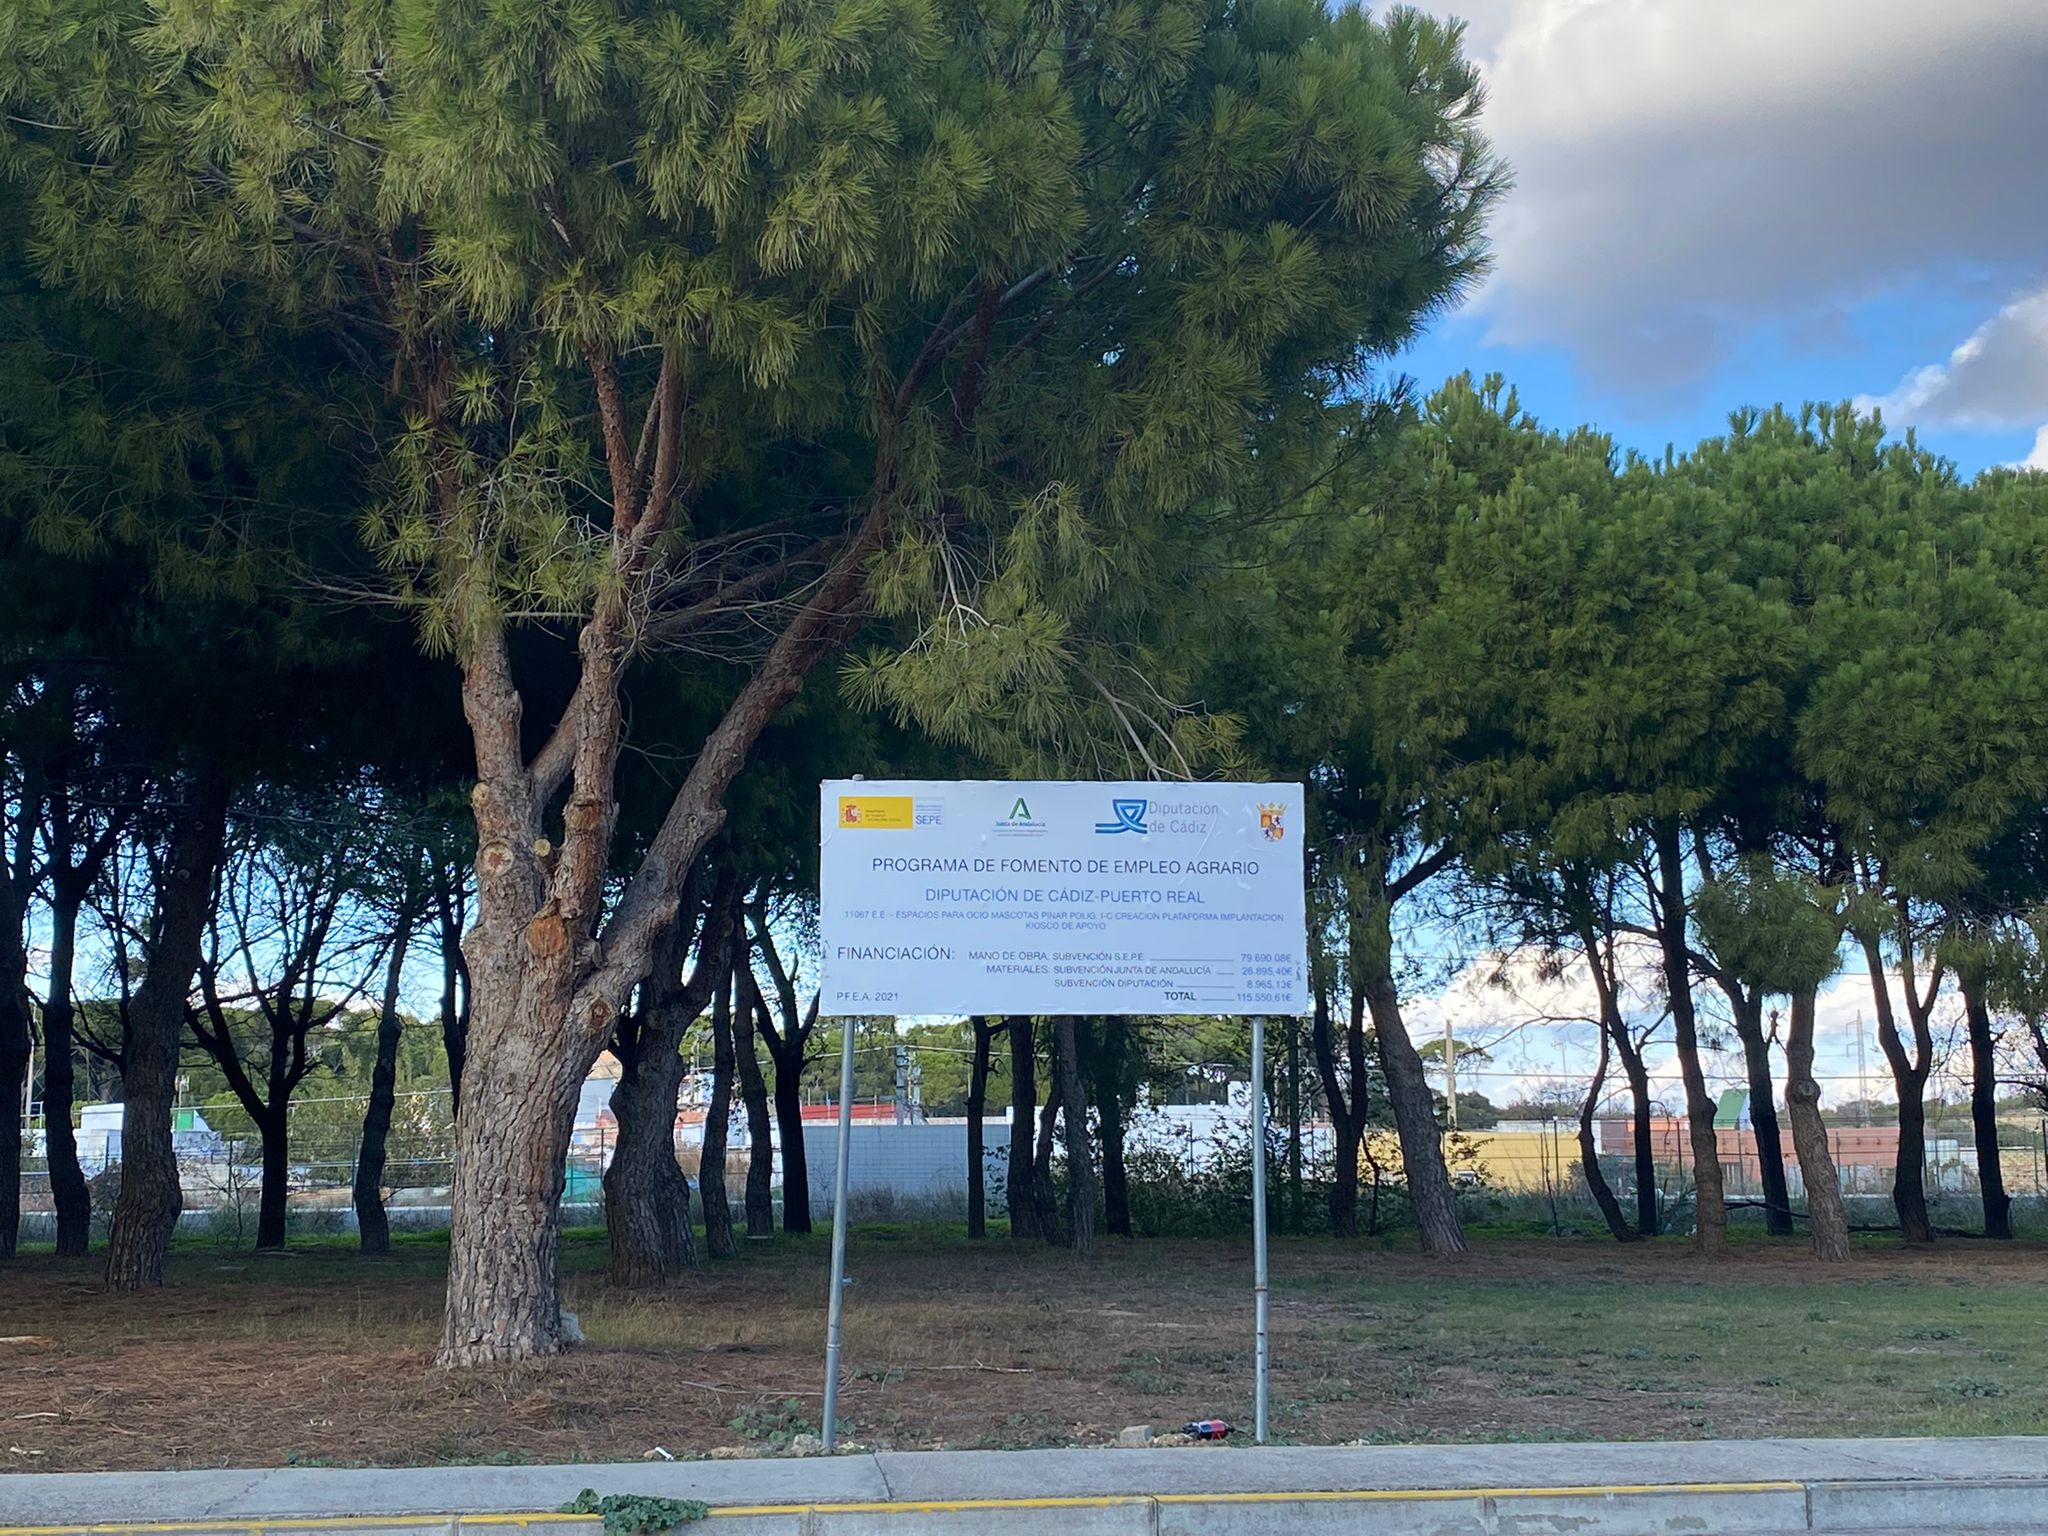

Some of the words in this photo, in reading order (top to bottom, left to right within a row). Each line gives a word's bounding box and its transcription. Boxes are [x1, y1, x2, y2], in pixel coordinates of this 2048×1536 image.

[1149, 800, 1219, 817] Diputación
[915, 815, 943, 825] SEPE
[1150, 819, 1165, 833] de
[1170, 818, 1206, 834] Cádiz
[872, 858, 968, 872] PROGRAMA
[974, 859, 995, 872] DE
[1001, 859, 1082, 873] FOMENTO
[1087, 860, 1109, 873] DE
[1114, 860, 1181, 874] EMPLEO
[1186, 861, 1260, 875] AGRARIO
[926, 886, 1018, 902] DIPUTACIÓN
[1023, 889, 1043, 902] DE
[1167, 890, 1205, 903] REAL
[896, 911, 939, 919] ESPACIOS
[942, 911, 965, 919] PARA
[966, 911, 988, 919] OCIO
[991, 911, 1039, 920] MASCOTAS
[1041, 911, 1067, 920] PINAR
[1162, 912, 1218, 920] PLATAFORMA
[1026, 922, 1060, 930] KIOSCO
[1061, 921, 1073, 930] DE
[1075, 922, 1106, 930] APOYO
[838, 944, 955, 960] FINANCIACIÓN:
[968, 951, 1000, 960] MANO
[1002, 951, 1016, 960] DE
[1052, 951, 1112, 961] SUBVENCIÓN
[986, 964, 1050, 974] MATERIALES:
[1053, 965, 1113, 974] SUBVENCIÓN
[1114, 965, 1142, 974] JUNTA
[1145, 966, 1157, 974] DE
[1160, 965, 1211, 975] ANDALUCÍA
[1054, 978, 1115, 988] SUBVENCIÓN
[1117, 978, 1174, 988] DIPUTACIÓN
[875, 992, 898, 1001] 2021
[1164, 991, 1197, 1001] TOTAL
